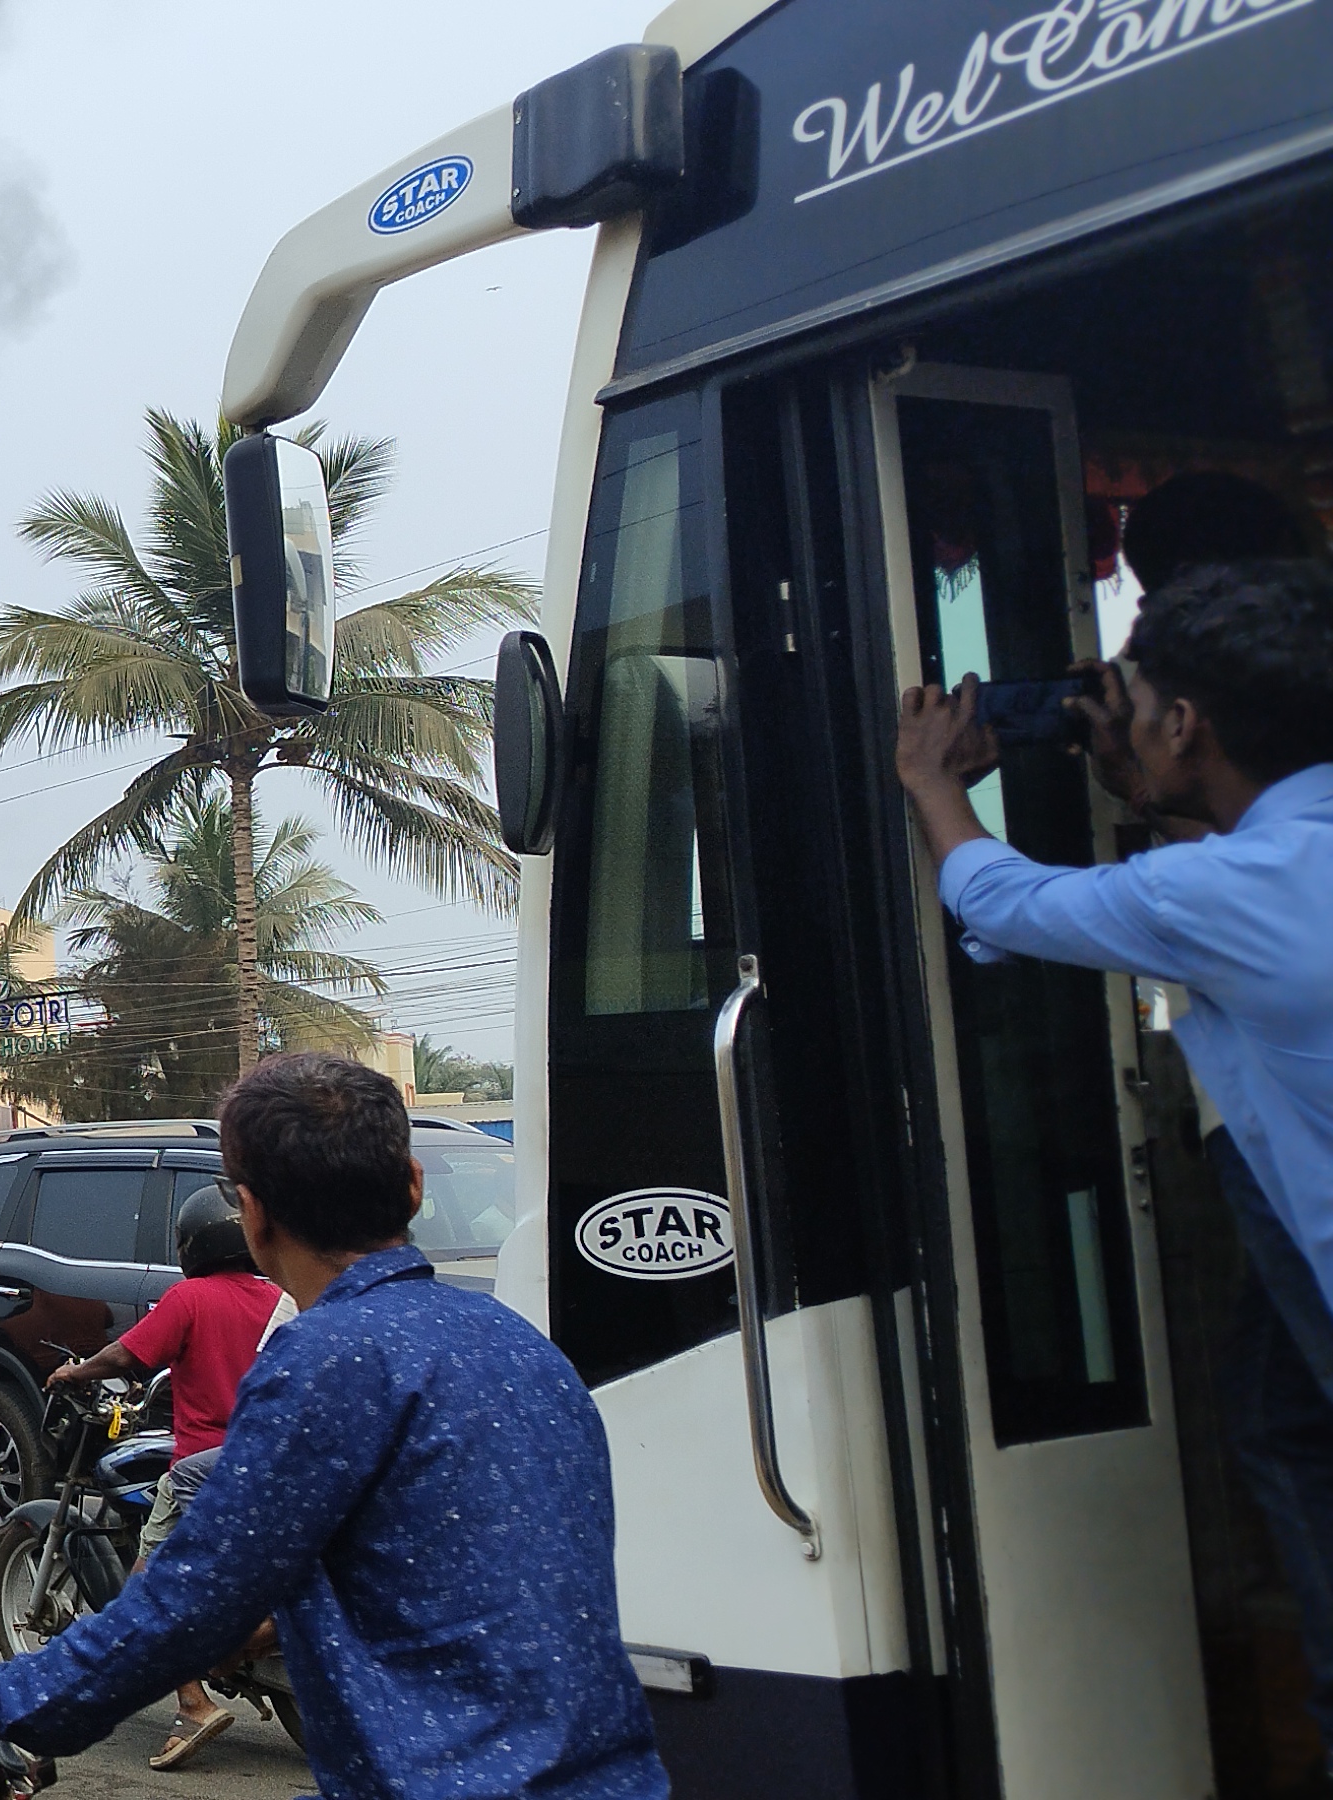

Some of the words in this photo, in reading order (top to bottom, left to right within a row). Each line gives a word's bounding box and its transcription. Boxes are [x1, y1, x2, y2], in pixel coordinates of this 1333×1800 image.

[382, 167, 458, 222] STAR
[395, 192, 445, 222] COACH
[599, 1206, 726, 1250] STAR
[622, 1241, 703, 1263] COACH
